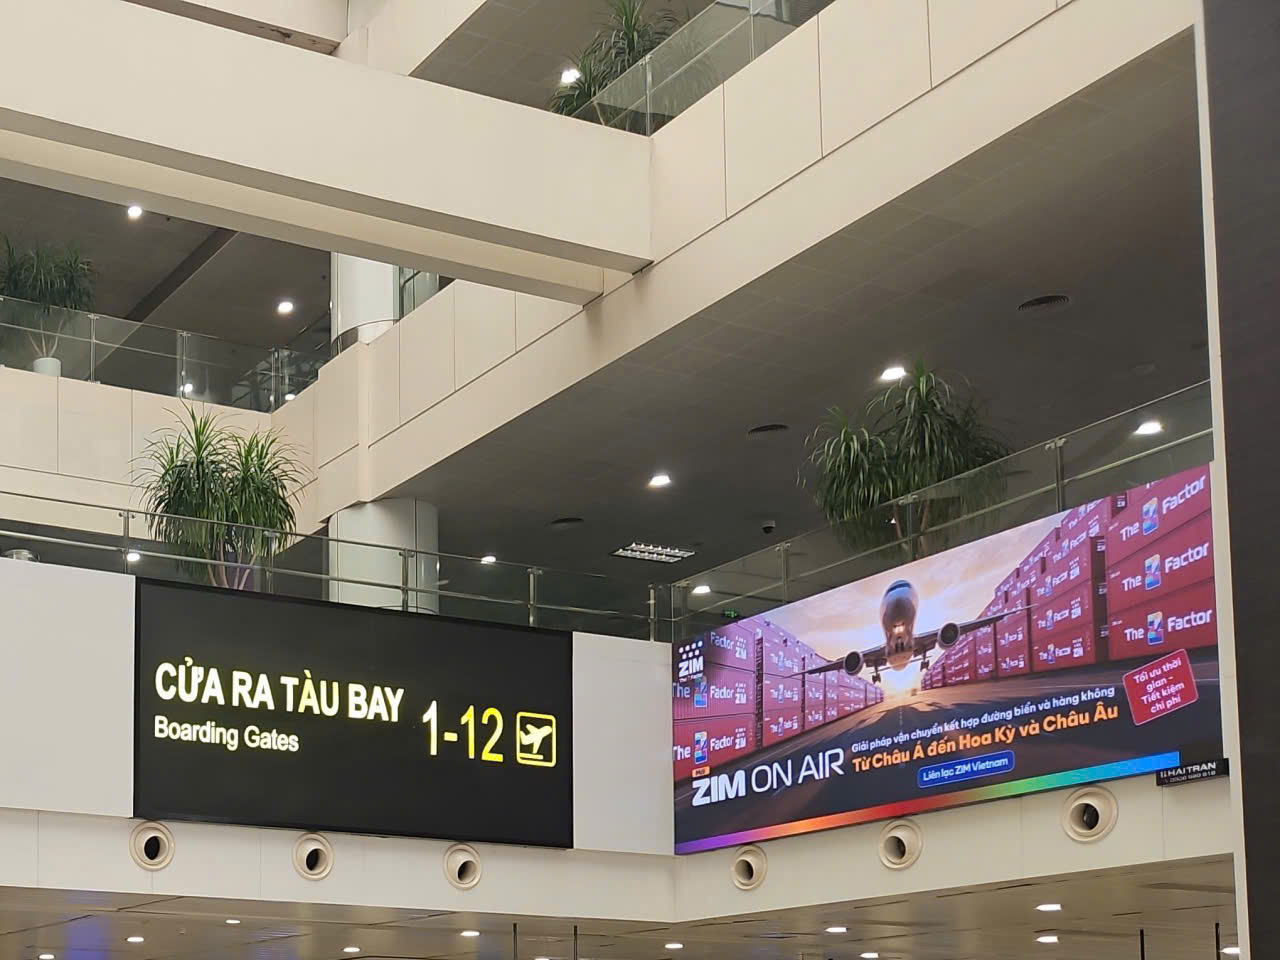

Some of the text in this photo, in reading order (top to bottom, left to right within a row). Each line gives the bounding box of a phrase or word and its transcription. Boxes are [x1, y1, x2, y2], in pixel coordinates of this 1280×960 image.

[1120, 475, 1206, 541] The Factor
[1122, 543, 1209, 591] The Factor
[1124, 609, 1212, 642] The Factor
[678, 656, 704, 679] ZIM
[1133, 657, 1182, 684] Tối ưu thời
[1146, 677, 1166, 693] gian
[155, 656, 404, 722] CỬA RA TÀU BAY
[1141, 682, 1185, 705] Tiết kiệm
[1166, 695, 1181, 709] phí
[155, 715, 299, 752] Boarding Gates
[422, 700, 504, 763] 1-12
[851, 686, 1115, 753] Giải pháp vận chuyển kết hợp đường biển và hàng không
[852, 702, 1118, 773] Từ Châu Á đến Hoa Kỳ và Châu Âu
[692, 748, 844, 807] ZIM ON AIR
[923, 757, 1008, 782] Liên lạc ZIM Vietnam
